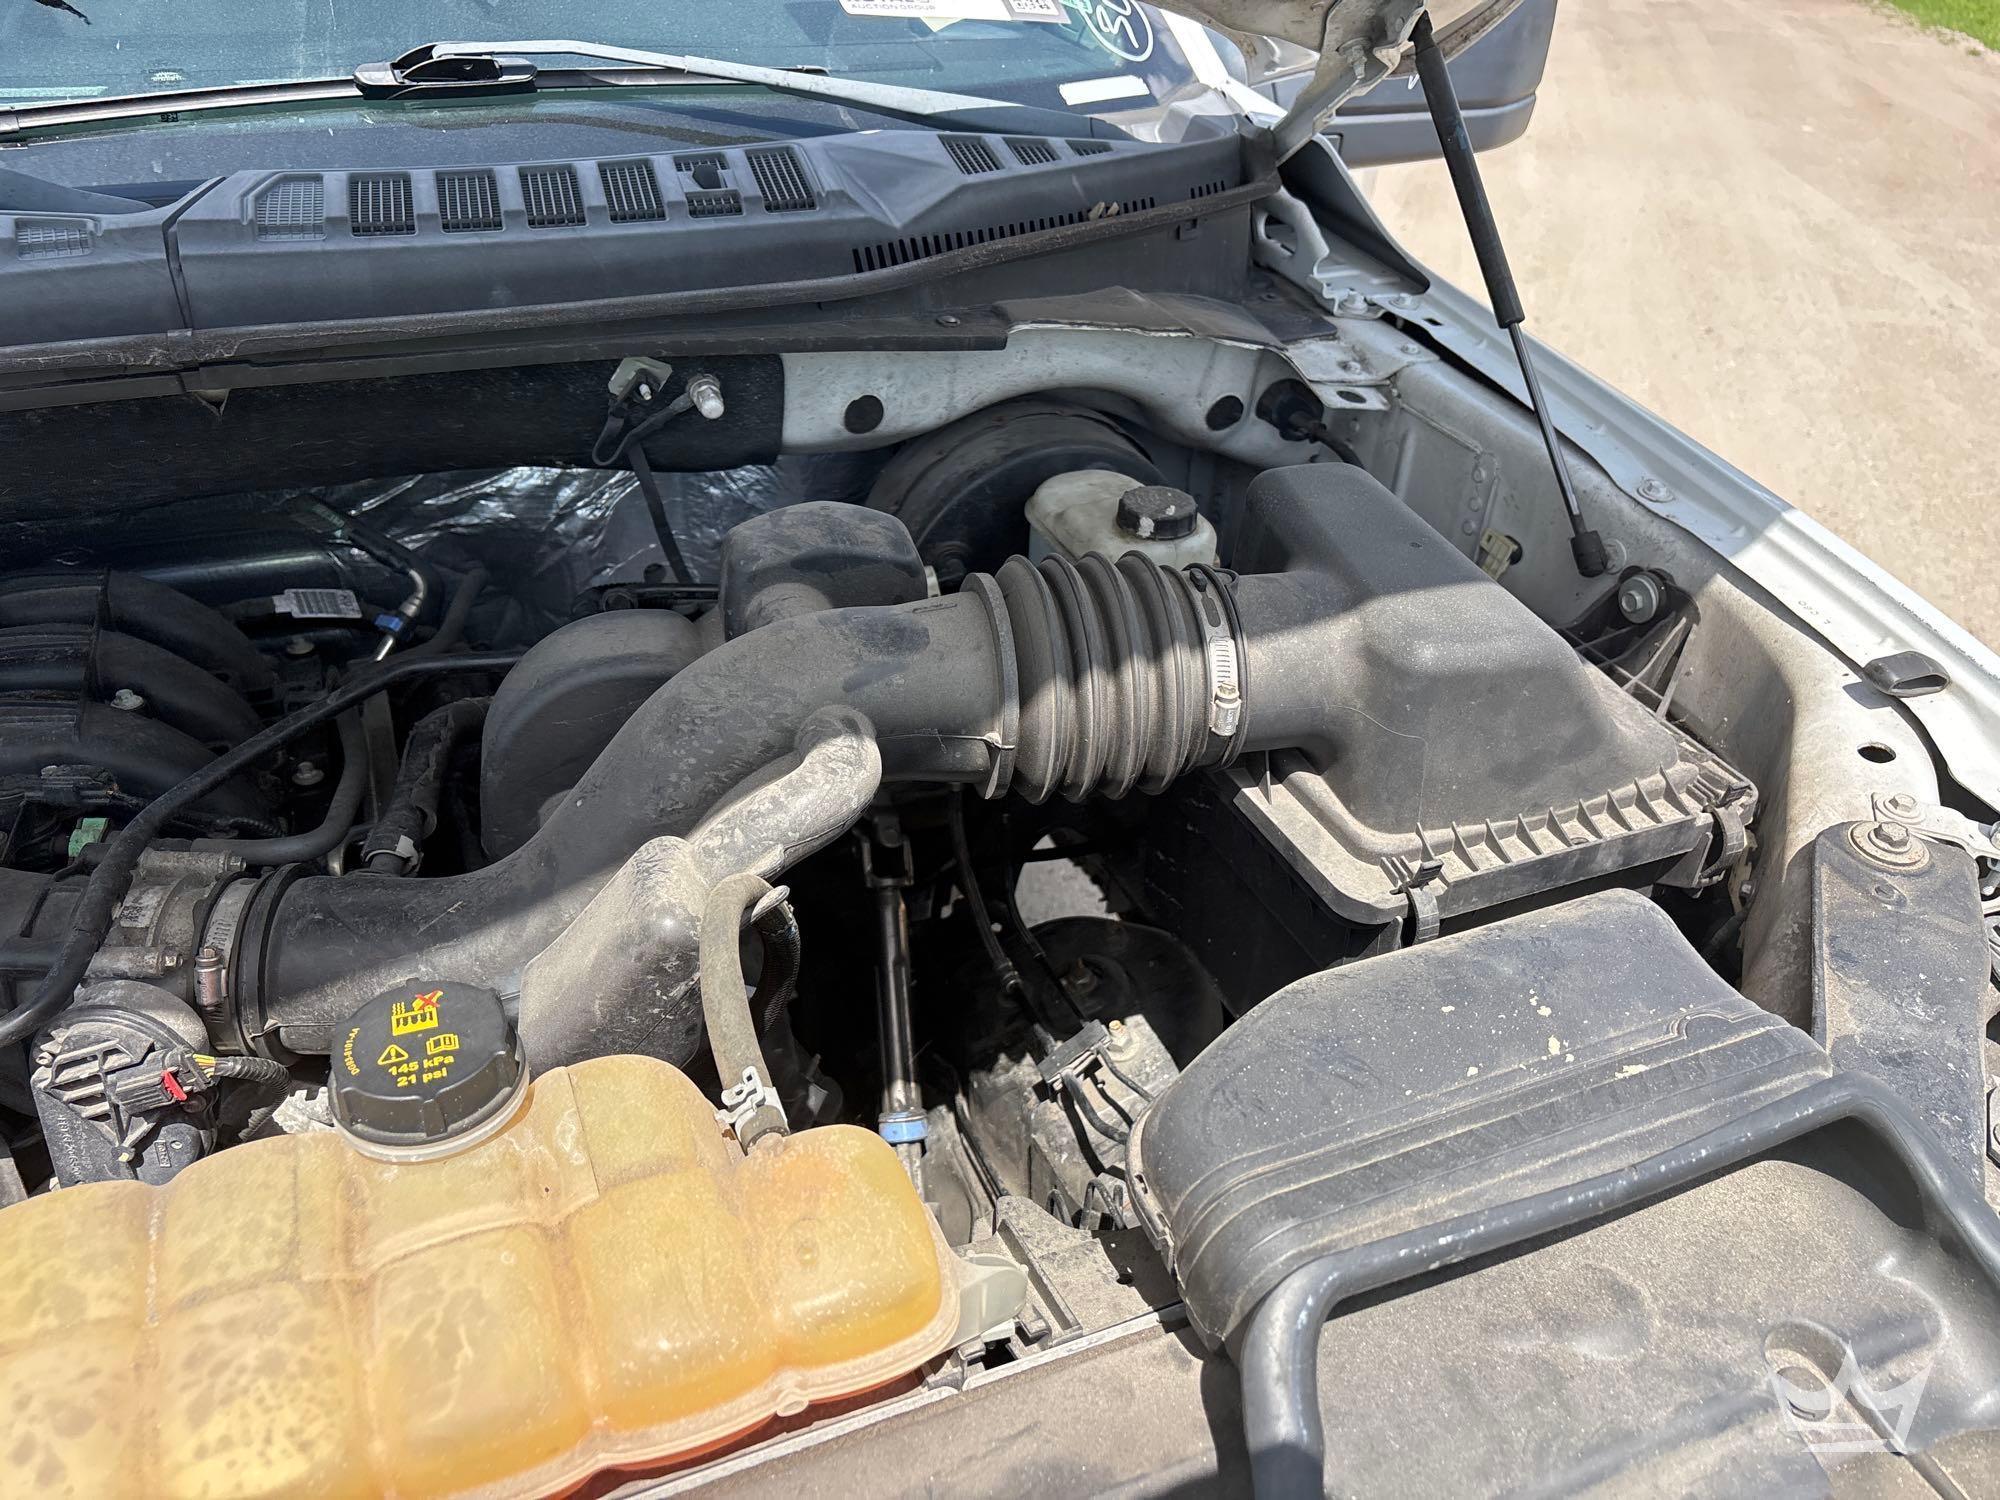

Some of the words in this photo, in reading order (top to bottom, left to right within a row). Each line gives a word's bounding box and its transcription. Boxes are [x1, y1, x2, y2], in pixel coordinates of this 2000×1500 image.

[388, 1061, 420, 1076] 145
[422, 1055, 455, 1069] kPa
[396, 1073, 418, 1088] 21
[422, 1066, 448, 1084] psi
